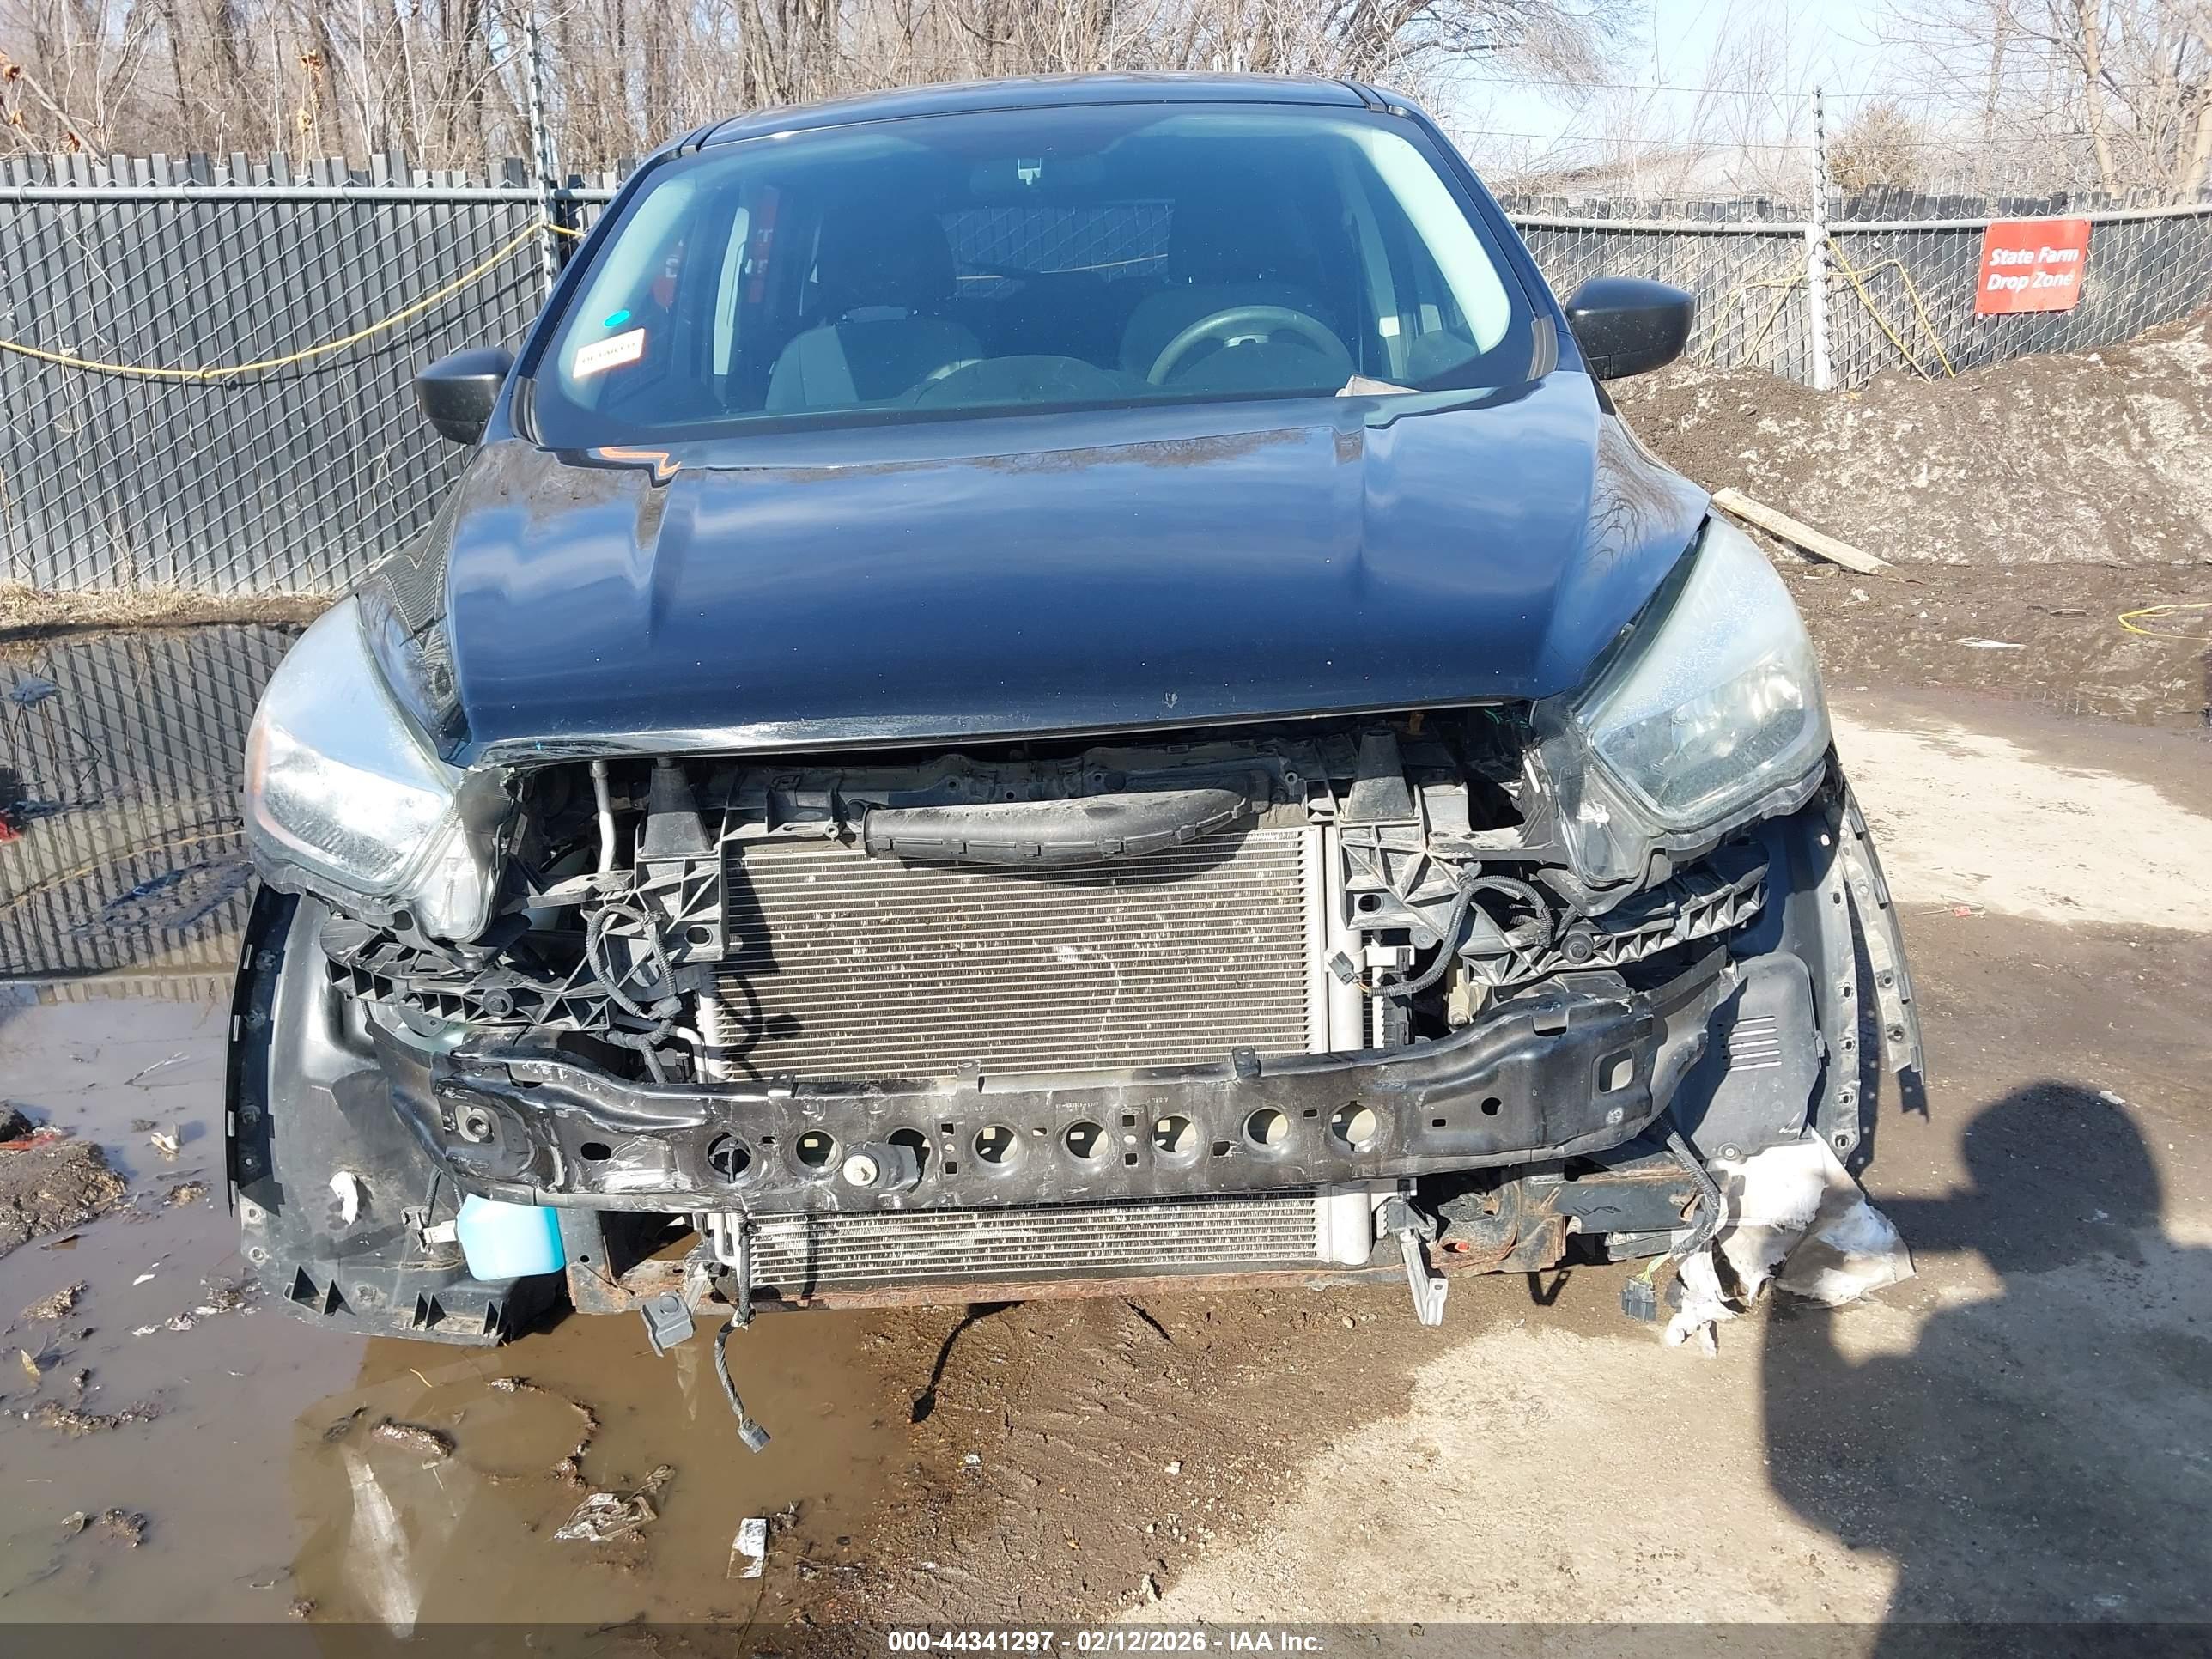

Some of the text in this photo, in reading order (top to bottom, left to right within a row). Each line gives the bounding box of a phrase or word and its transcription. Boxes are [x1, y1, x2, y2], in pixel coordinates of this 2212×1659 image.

[1989, 246, 2079, 266] State Farm
[1987, 270, 2075, 293] Drop Zone
